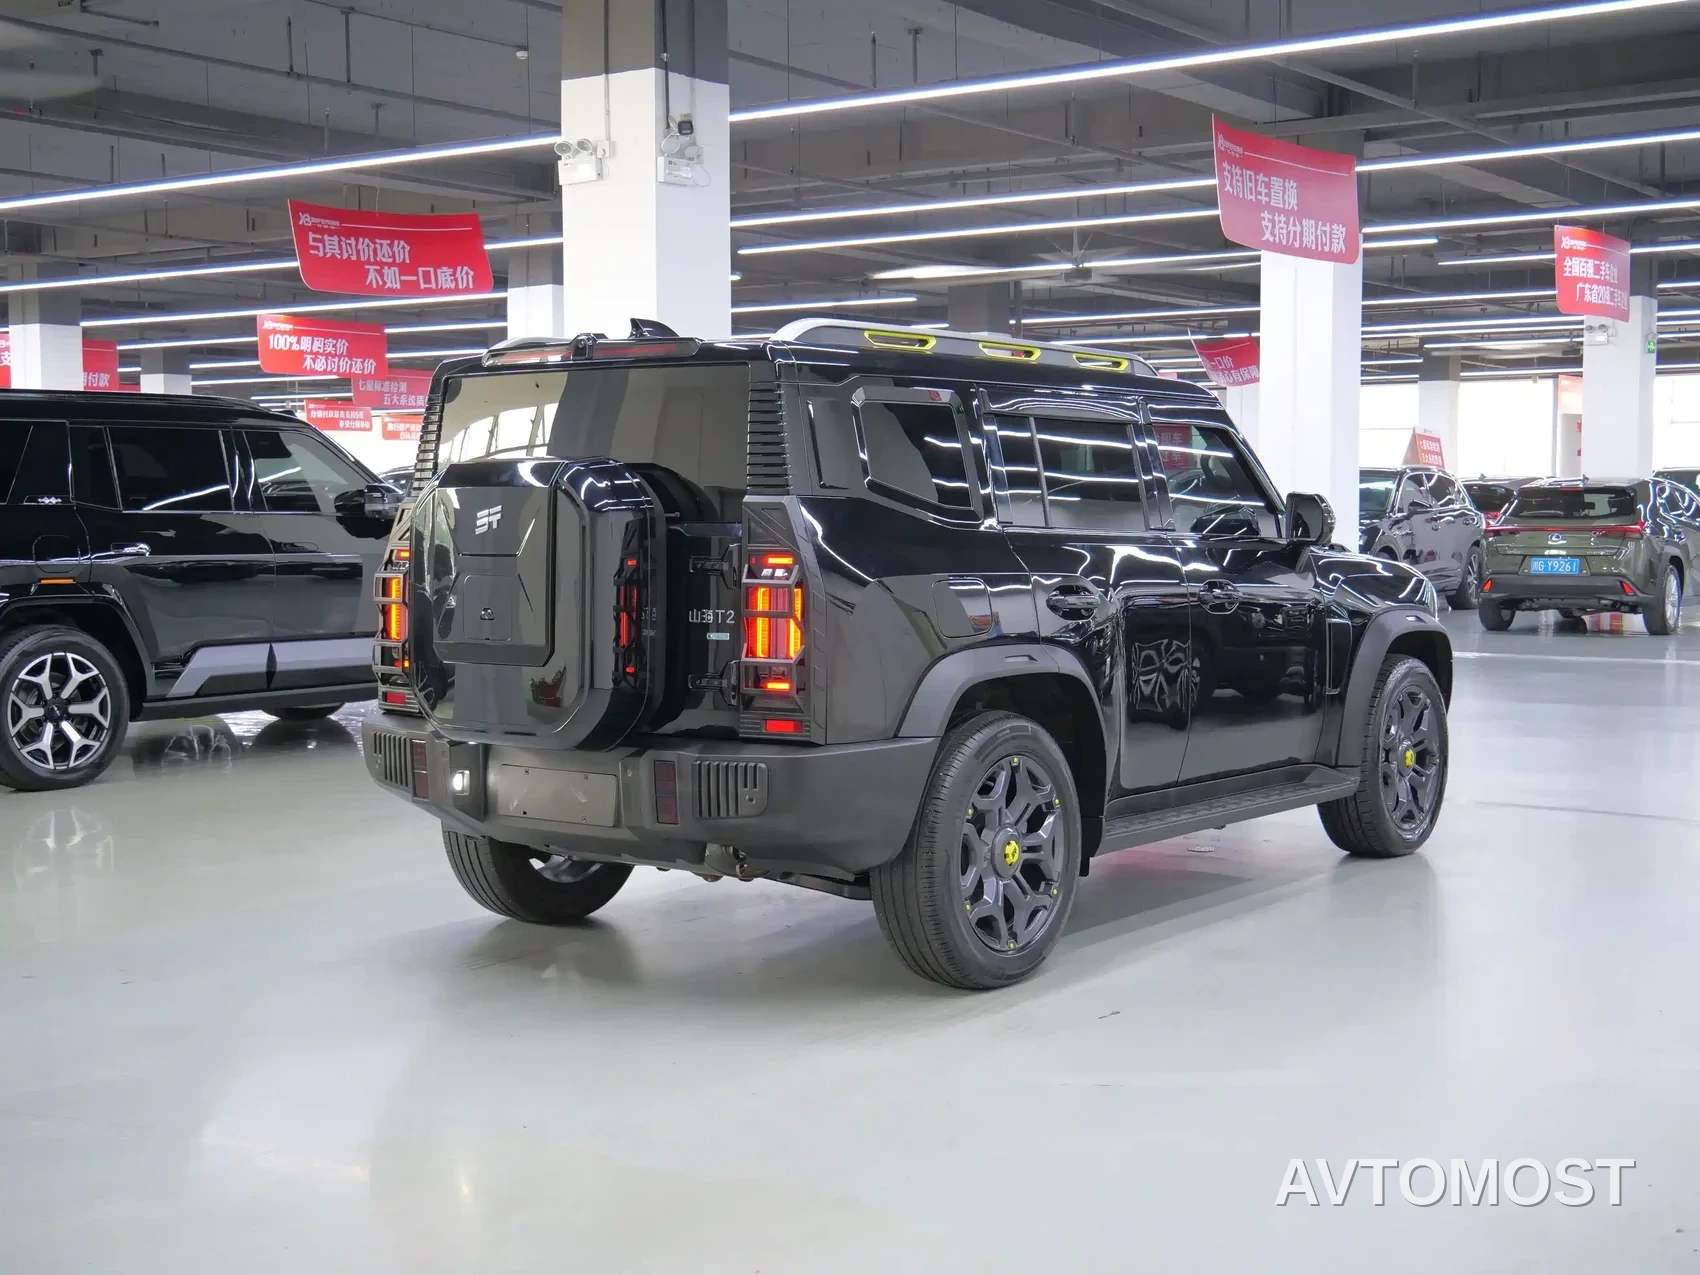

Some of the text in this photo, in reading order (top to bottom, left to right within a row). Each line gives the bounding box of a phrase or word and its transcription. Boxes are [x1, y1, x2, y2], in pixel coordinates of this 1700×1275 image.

[1222, 160, 1299, 211] 支持旧车置换
[1261, 210, 1347, 254] 支持分期付款
[364, 265, 475, 290] 不如一口底价
[268, 334, 349, 355] 100%明码实价
[302, 354, 377, 375] 不必讨价还价
